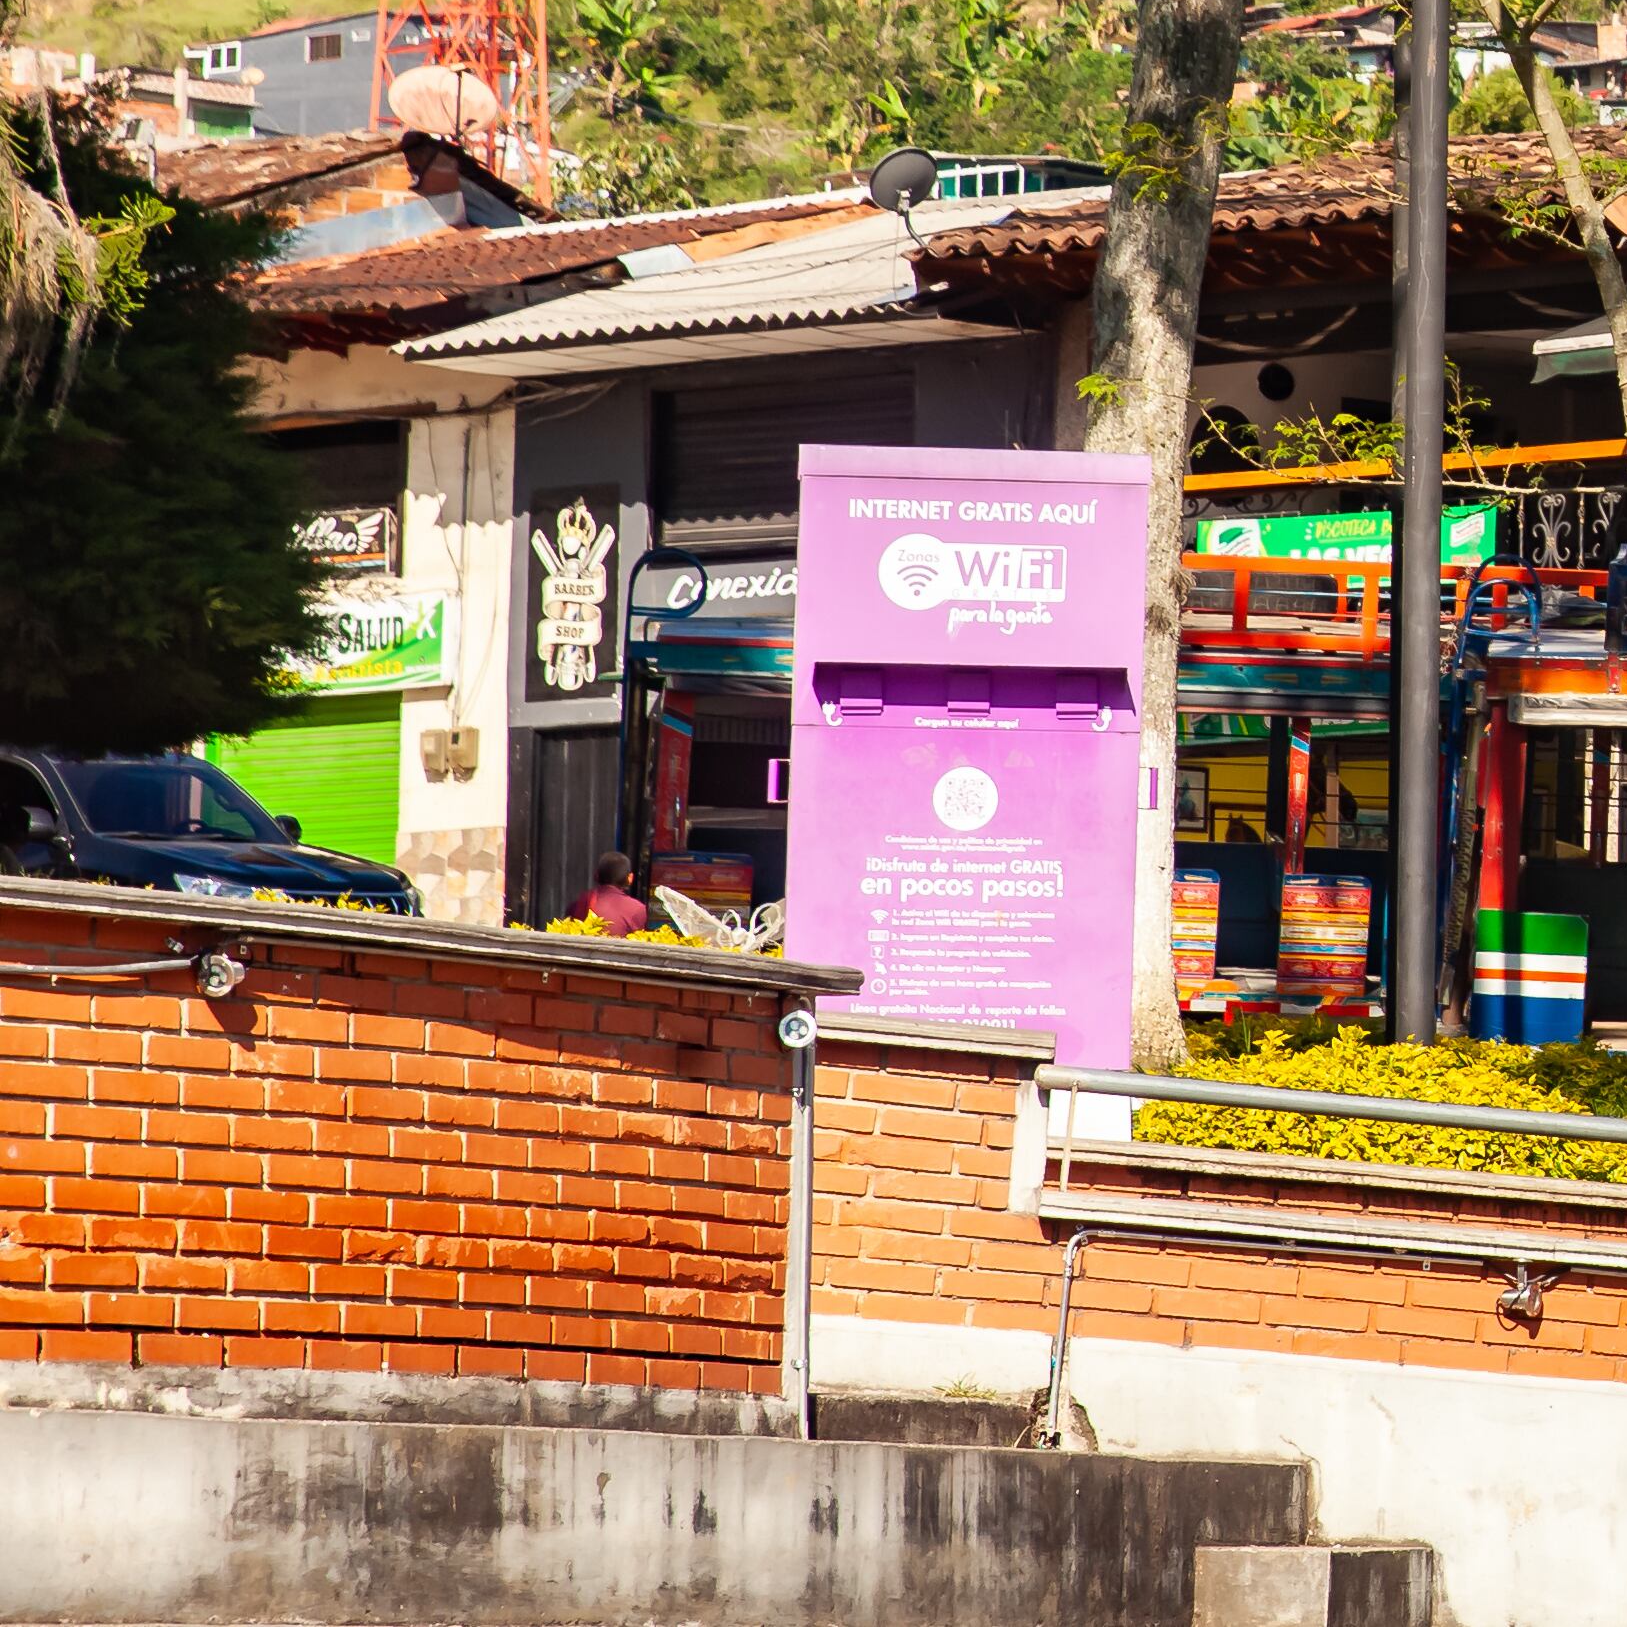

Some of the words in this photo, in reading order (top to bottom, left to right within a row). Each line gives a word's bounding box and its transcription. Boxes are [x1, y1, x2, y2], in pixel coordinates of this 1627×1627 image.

[849, 498, 953, 521] INTERNET
[958, 501, 1033, 523] GRATIS
[1037, 498, 1098, 525] AQUÍ
[1315, 519, 1376, 539] DISCOTECA
[897, 549, 940, 564] Zonas
[954, 549, 1055, 589] WiFi
[554, 583, 595, 596] BARBER
[947, 606, 987, 634] para
[1000, 601, 1053, 635] gente
[555, 625, 585, 638] SHOP
[866, 857, 927, 873] ¡Disfruta
[930, 858, 949, 873] de
[953, 858, 1006, 874] internet
[1010, 860, 1063, 875] GRATIS
[860, 876, 892, 895] en
[900, 877, 974, 903] pocos
[982, 874, 1064, 904] pasos!
[919, 1003, 965, 1014] Nacional
[968, 1005, 982, 1015] de
[1024, 1005, 1037, 1015] de
